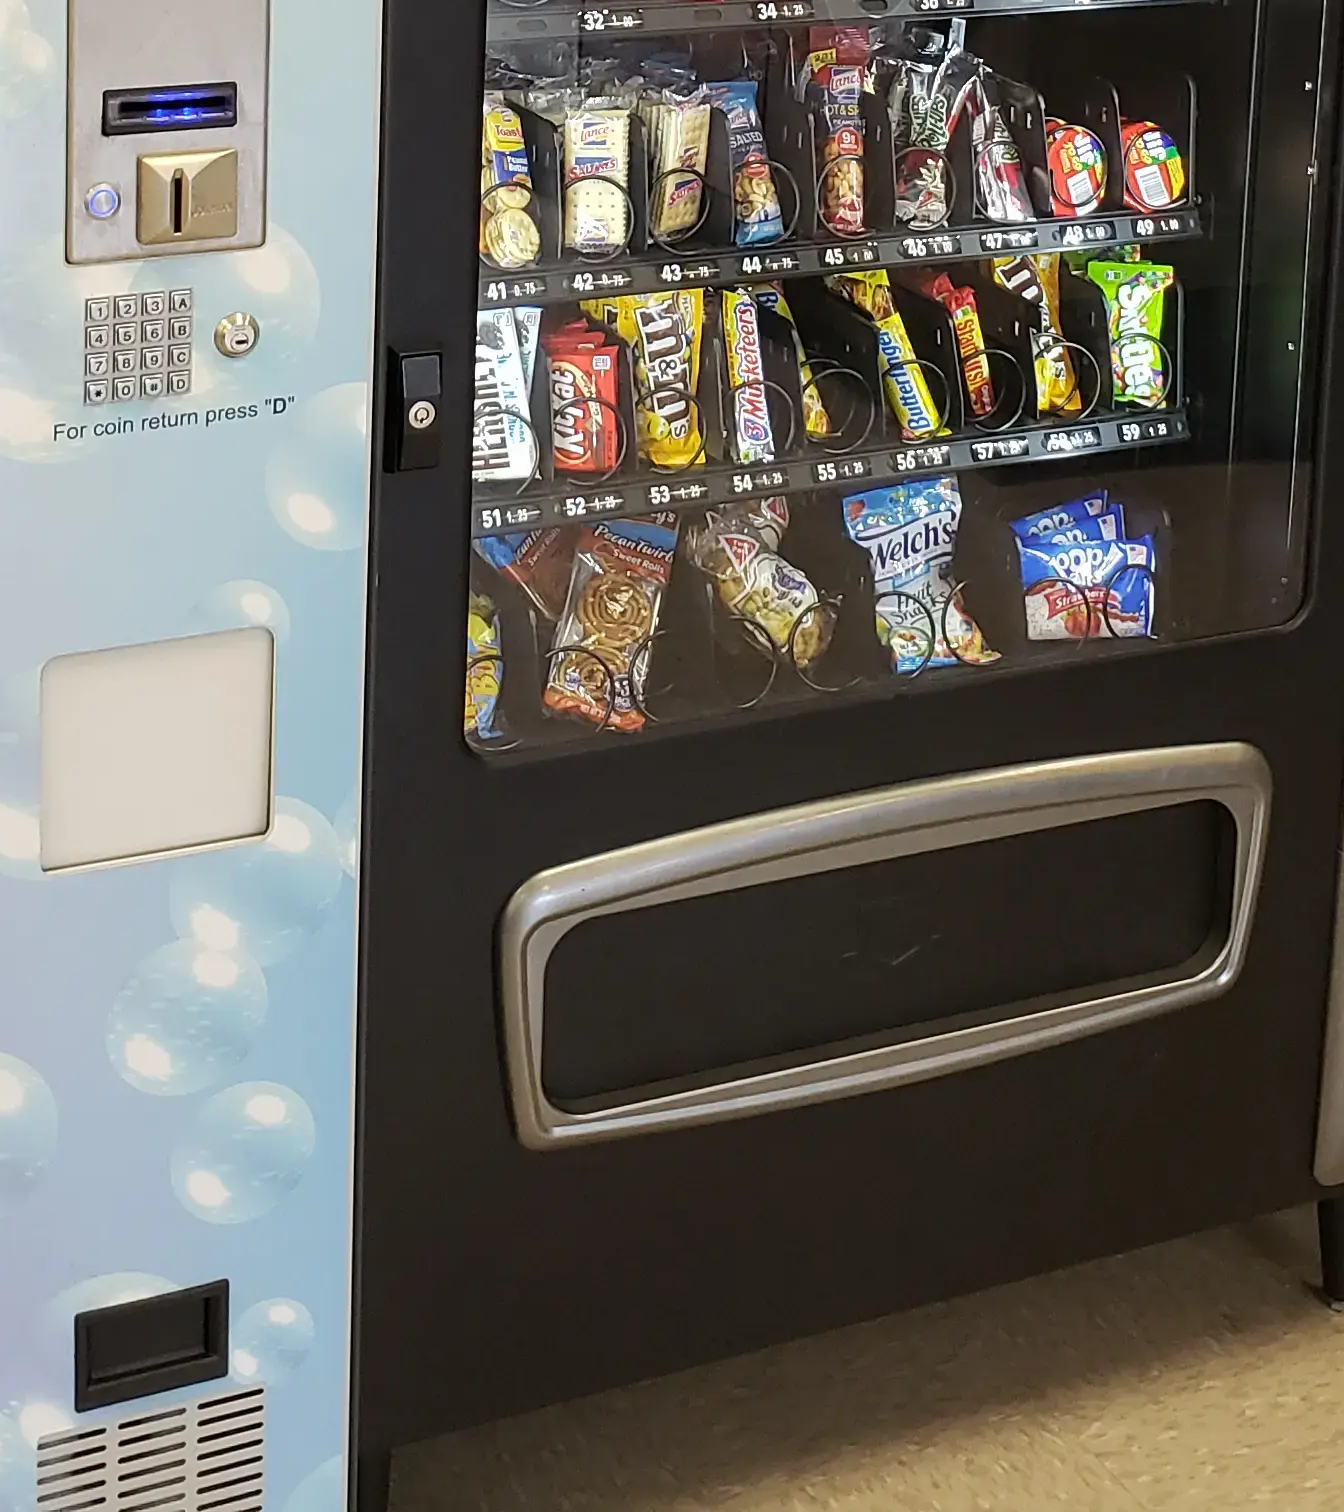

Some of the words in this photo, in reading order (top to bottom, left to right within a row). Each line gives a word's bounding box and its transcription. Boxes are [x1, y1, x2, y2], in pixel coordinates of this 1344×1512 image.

[757, 4, 777, 19] 34
[581, 126, 610, 141] Lance
[729, 132, 763, 148] SALTED
[574, 274, 594, 291] 42
[487, 283, 506, 300] 41
[737, 307, 767, 421] Musketeers
[879, 331, 930, 431] Butterfinger
[53, 424, 88, 442] For
[93, 416, 134, 436] coin
[141, 411, 198, 430] return
[205, 405, 258, 426] press
[264, 396, 295, 415] "D"
[745, 421, 767, 441] 3
[818, 464, 836, 480] 55
[733, 475, 752, 491] 54
[482, 512, 501, 527] 51
[873, 511, 955, 570] Welch's
[612, 548, 641, 566] Sweet
[642, 558, 664, 574] Rolls
[897, 583, 933, 610] Fruit
